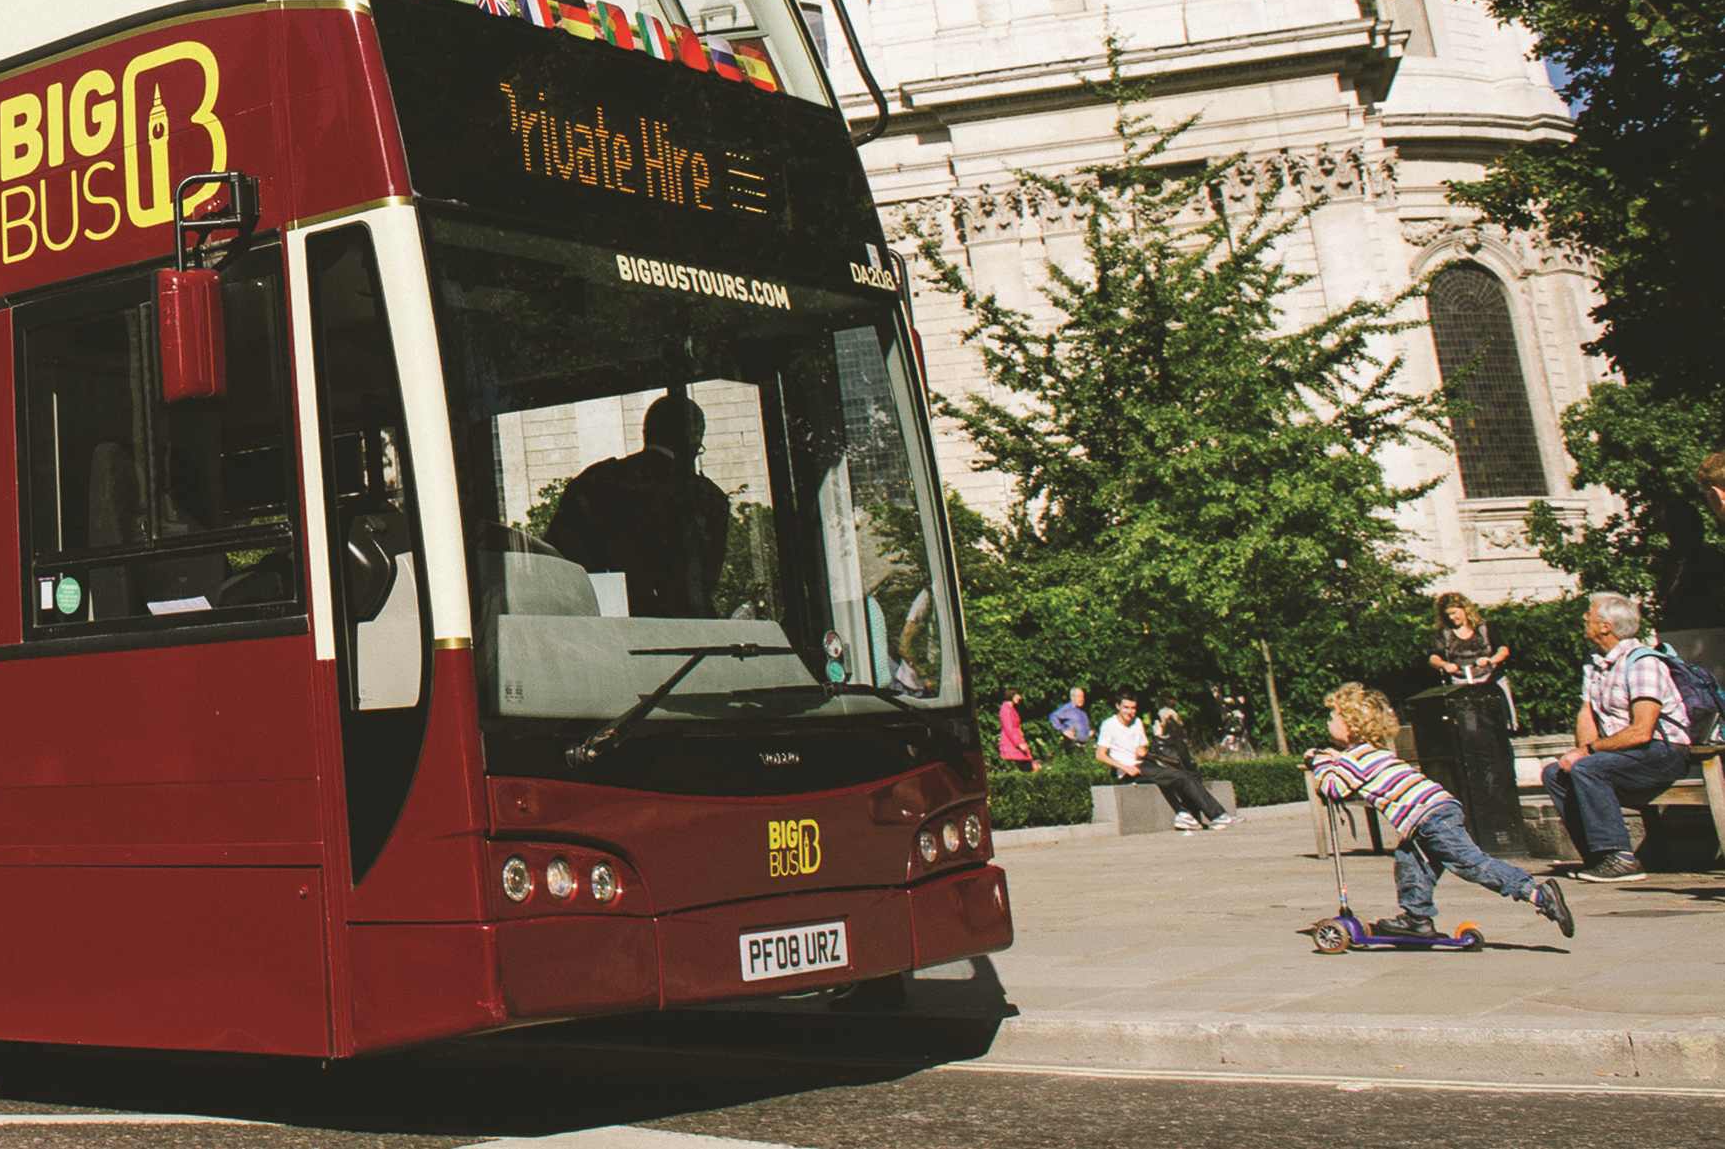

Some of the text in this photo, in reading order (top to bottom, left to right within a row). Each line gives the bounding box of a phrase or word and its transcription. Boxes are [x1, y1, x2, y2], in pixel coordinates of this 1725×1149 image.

[0, 69, 117, 182] BIG
[640, 117, 713, 211] Hire
[1, 160, 121, 265] BUS
[616, 254, 791, 311] BIGBUSTOURS.COM
[850, 262, 896, 292] DA208
[769, 820, 798, 850] BIG
[770, 850, 799, 877] BUS
[749, 929, 841, 974] PF08 URZ
